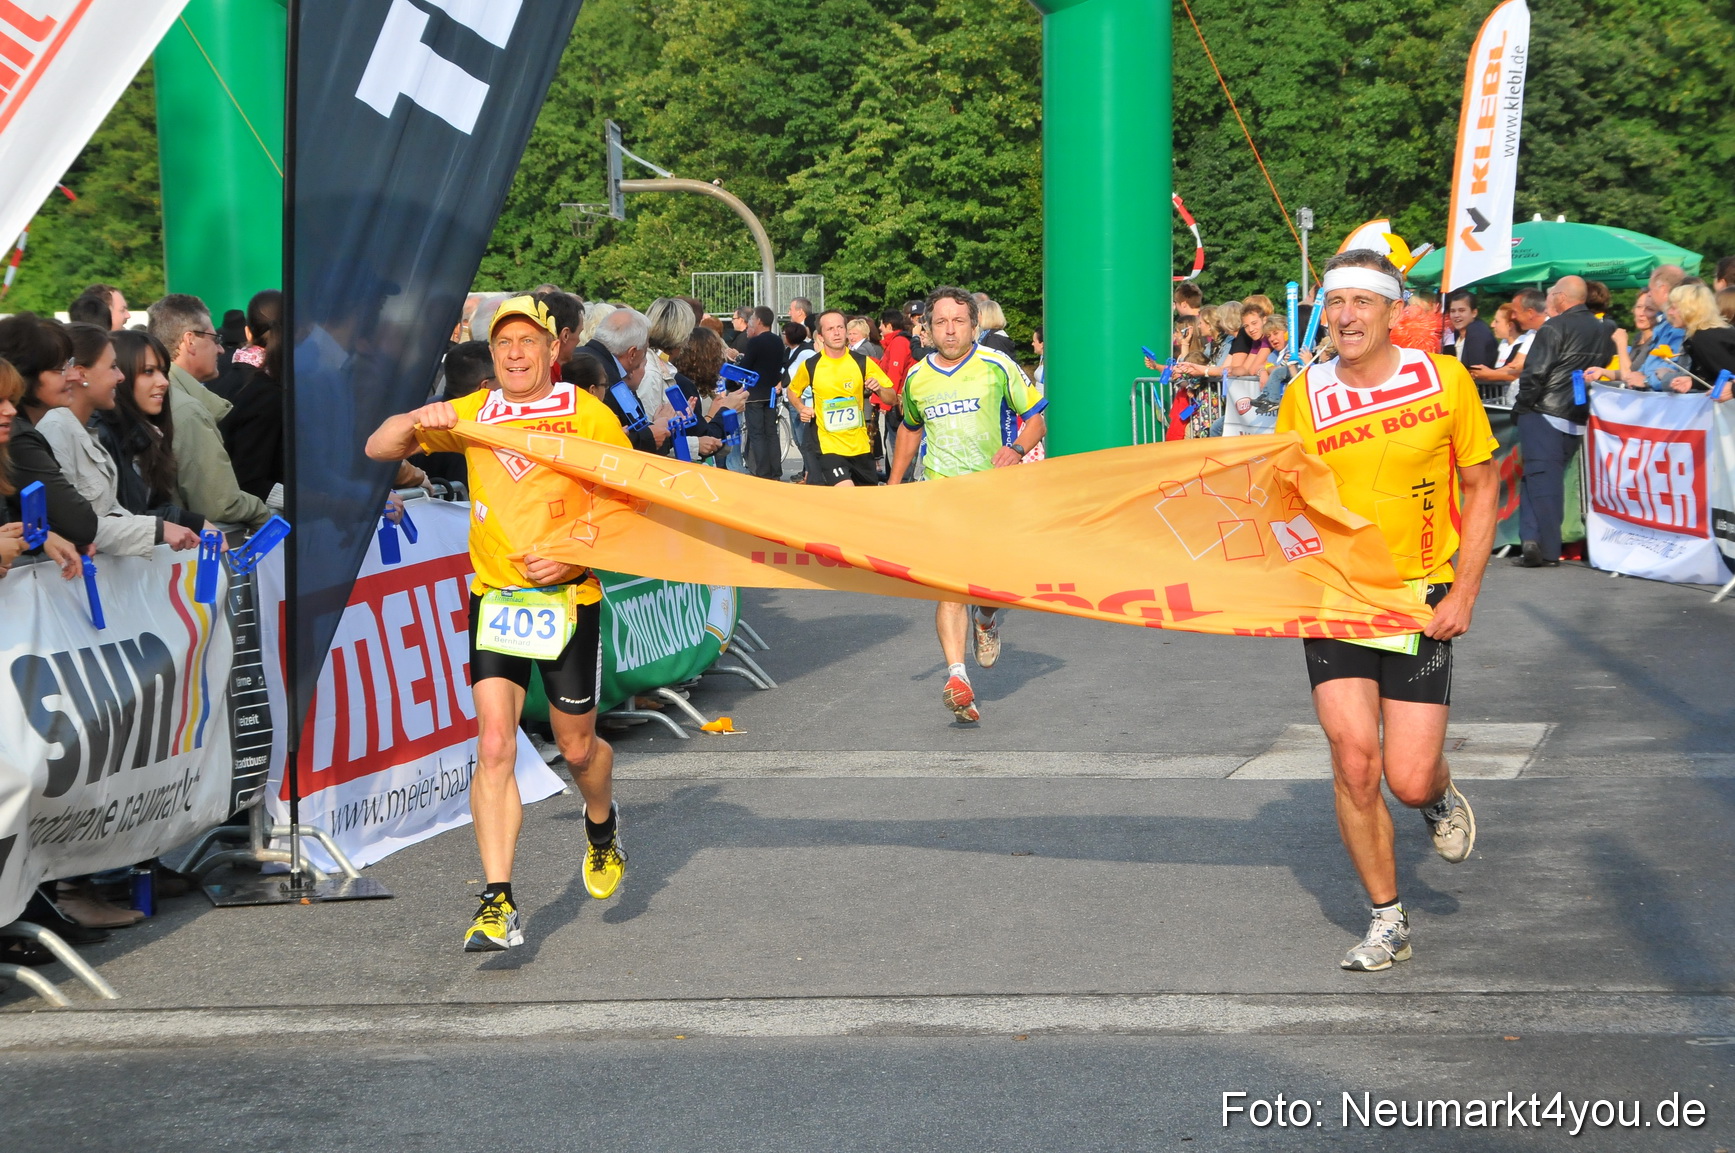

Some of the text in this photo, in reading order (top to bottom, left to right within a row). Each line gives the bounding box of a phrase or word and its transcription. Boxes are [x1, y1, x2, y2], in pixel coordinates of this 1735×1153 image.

[1471, 30, 1508, 195] KLEBL
[1504, 45, 1525, 158] www.klebl.de
[922, 390, 957, 405] TEAM
[924, 397, 981, 420] BOCK
[827, 408, 855, 424] 773
[1316, 402, 1450, 456] MAX BÖGL
[832, 467, 844, 477] 11
[1594, 428, 1697, 529] MEIER
[488, 606, 556, 640] 403
[494, 635, 531, 646] Bernhard
